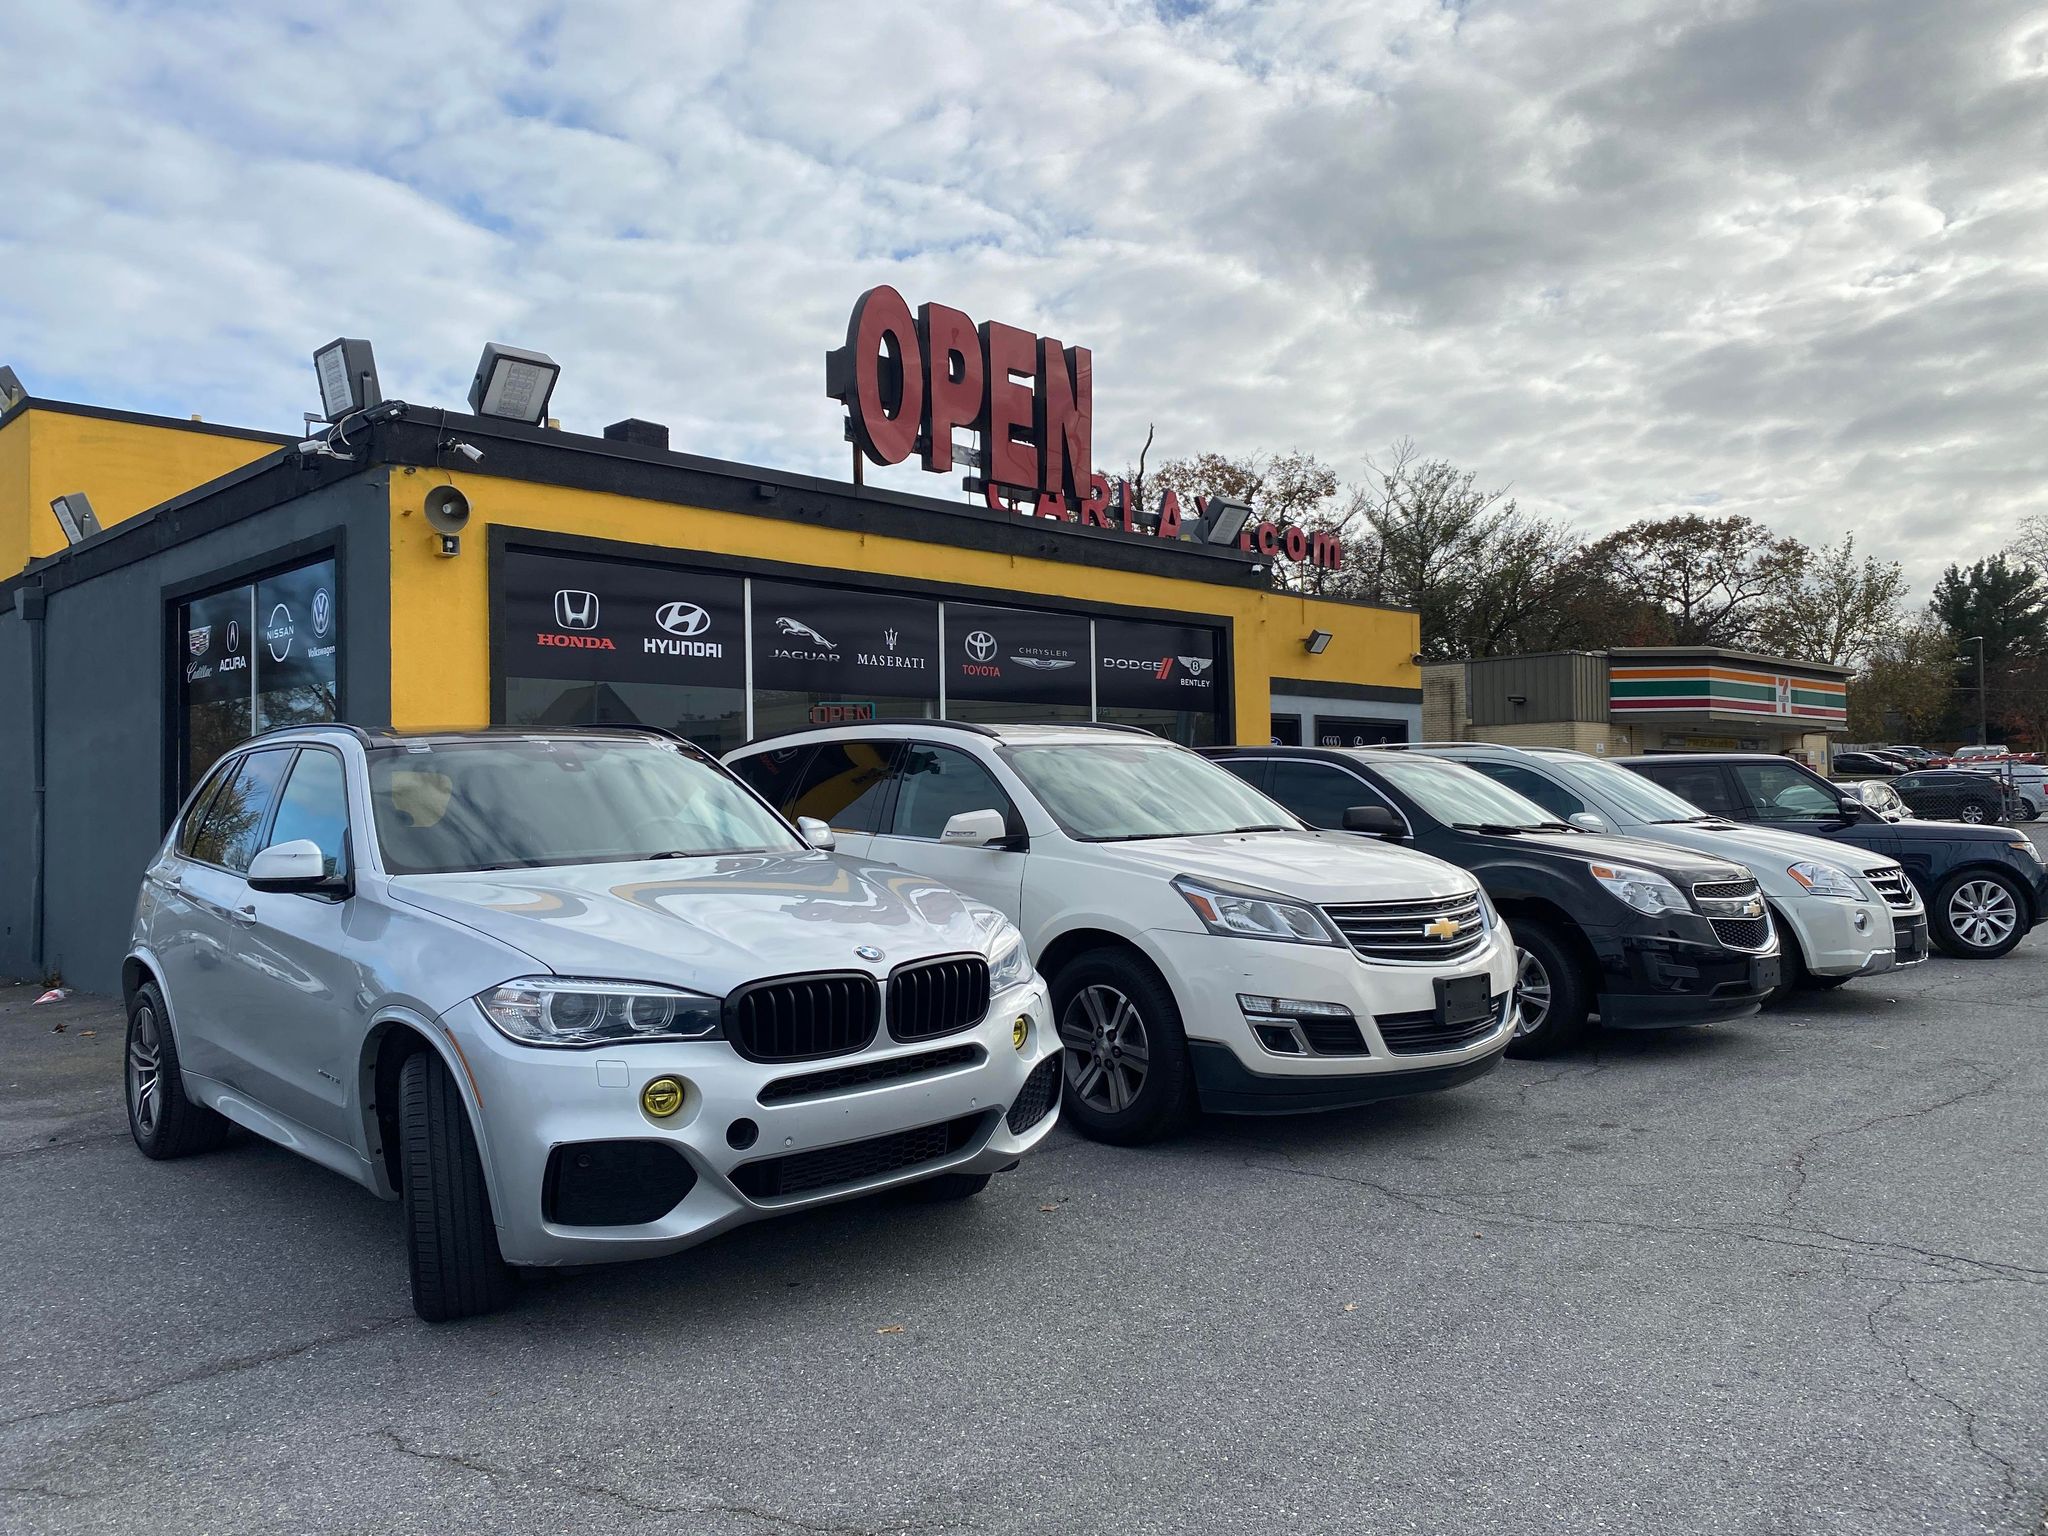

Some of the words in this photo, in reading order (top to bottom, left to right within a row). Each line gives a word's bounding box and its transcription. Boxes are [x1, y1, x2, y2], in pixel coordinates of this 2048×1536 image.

[848, 285, 1091, 499] OPEN
[266, 625, 295, 640] NISSAN
[537, 633, 616, 650] HONDA
[643, 638, 722, 658] HYUNDAI
[307, 645, 336, 658] Volkswagen
[768, 649, 840, 662] JAGUAR
[1018, 647, 1068, 657] CHRYSLER
[219, 655, 247, 672] ACURA
[857, 653, 925, 669] MASERATI
[186, 661, 212, 683] Cadillac
[962, 664, 1000, 678] TOYOTA
[1180, 678, 1210, 687] BENTLEY
[813, 705, 872, 723] OPEN
